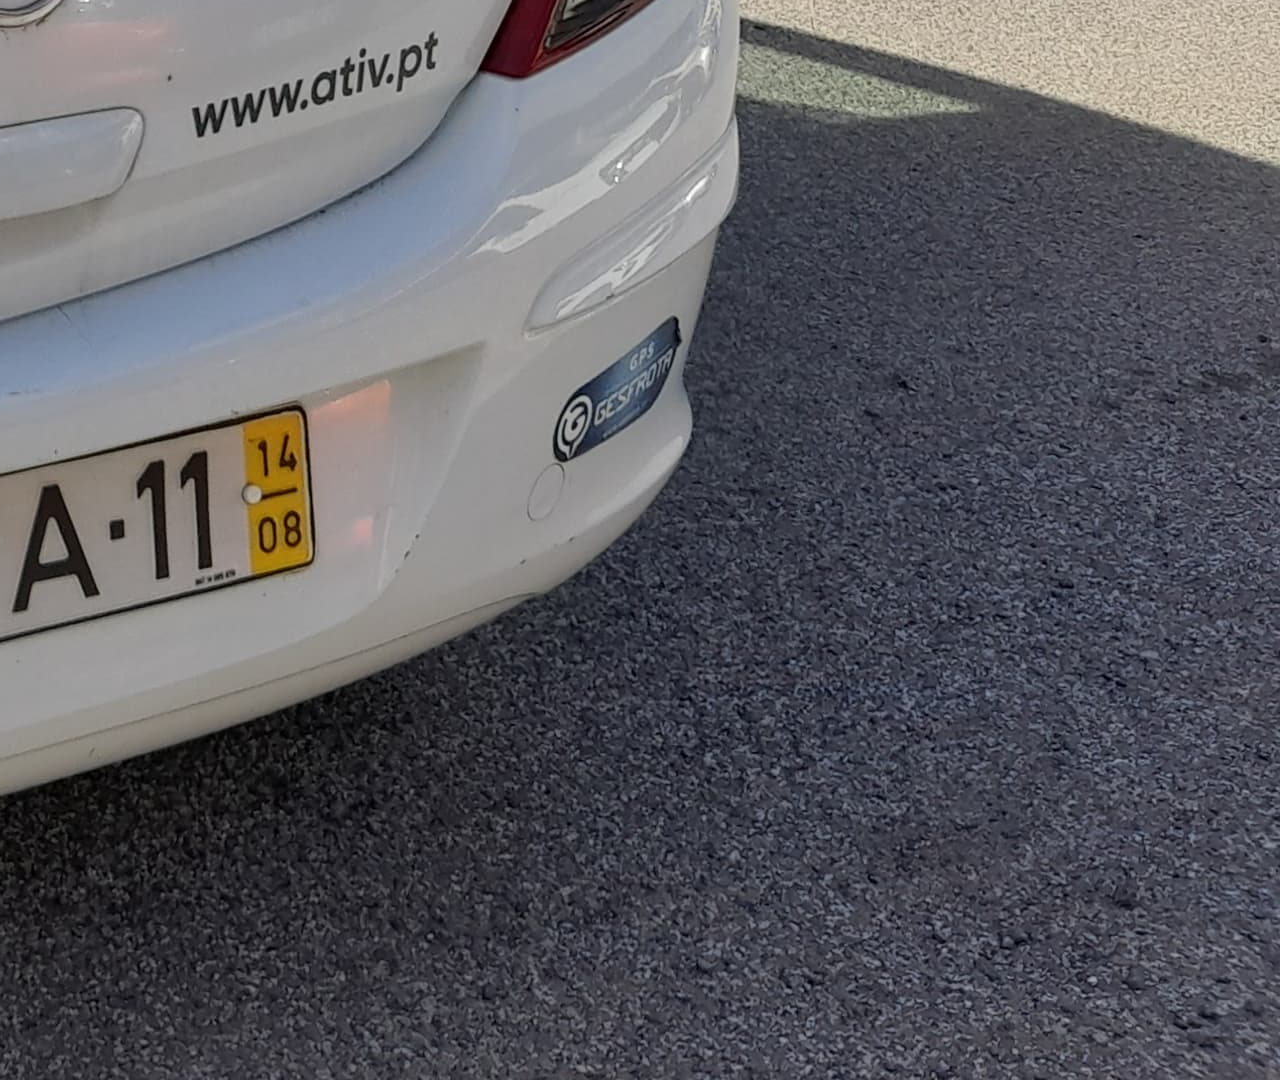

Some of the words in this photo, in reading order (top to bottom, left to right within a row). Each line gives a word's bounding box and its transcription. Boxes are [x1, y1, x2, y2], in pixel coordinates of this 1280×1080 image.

[192, 31, 438, 138] www.ativ.pt
[629, 341, 656, 371] GPS
[593, 348, 675, 426] GESFROTA
[257, 433, 298, 477] 14
[258, 510, 302, 553] 08
